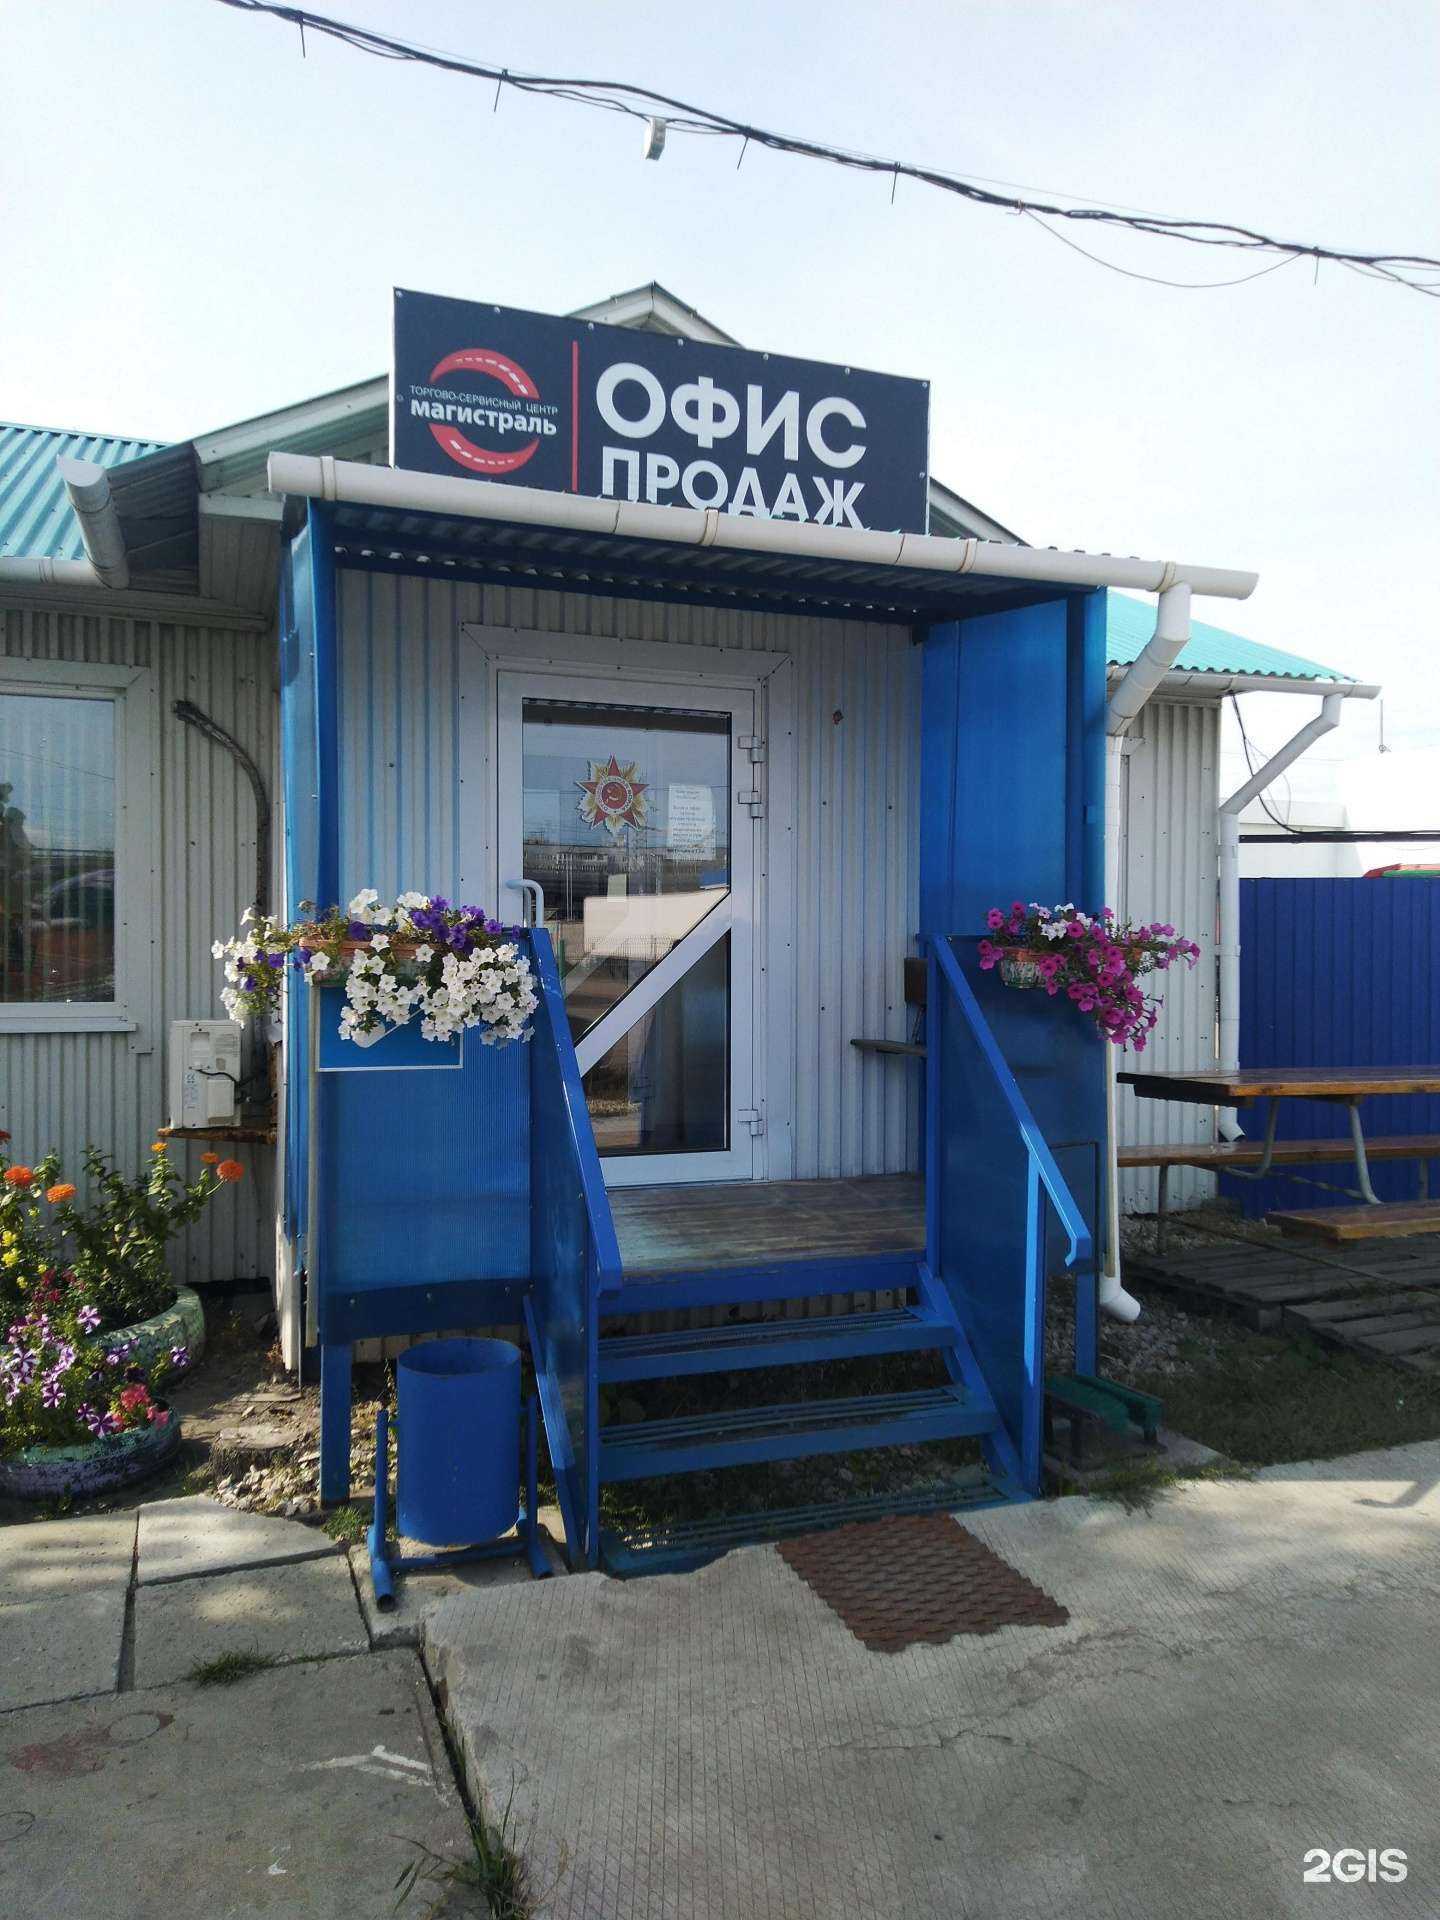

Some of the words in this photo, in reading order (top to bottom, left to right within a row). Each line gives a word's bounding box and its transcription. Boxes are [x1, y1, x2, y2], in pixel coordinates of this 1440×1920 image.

[410, 385, 521, 411] ТОРГОВО-СЕРВИСНЫЙ
[526, 402, 559, 416] ЦЕНТР
[410, 399, 557, 436] магистраль
[596, 362, 867, 470] ОФИС
[601, 446, 867, 528] ПРОДАЖ
